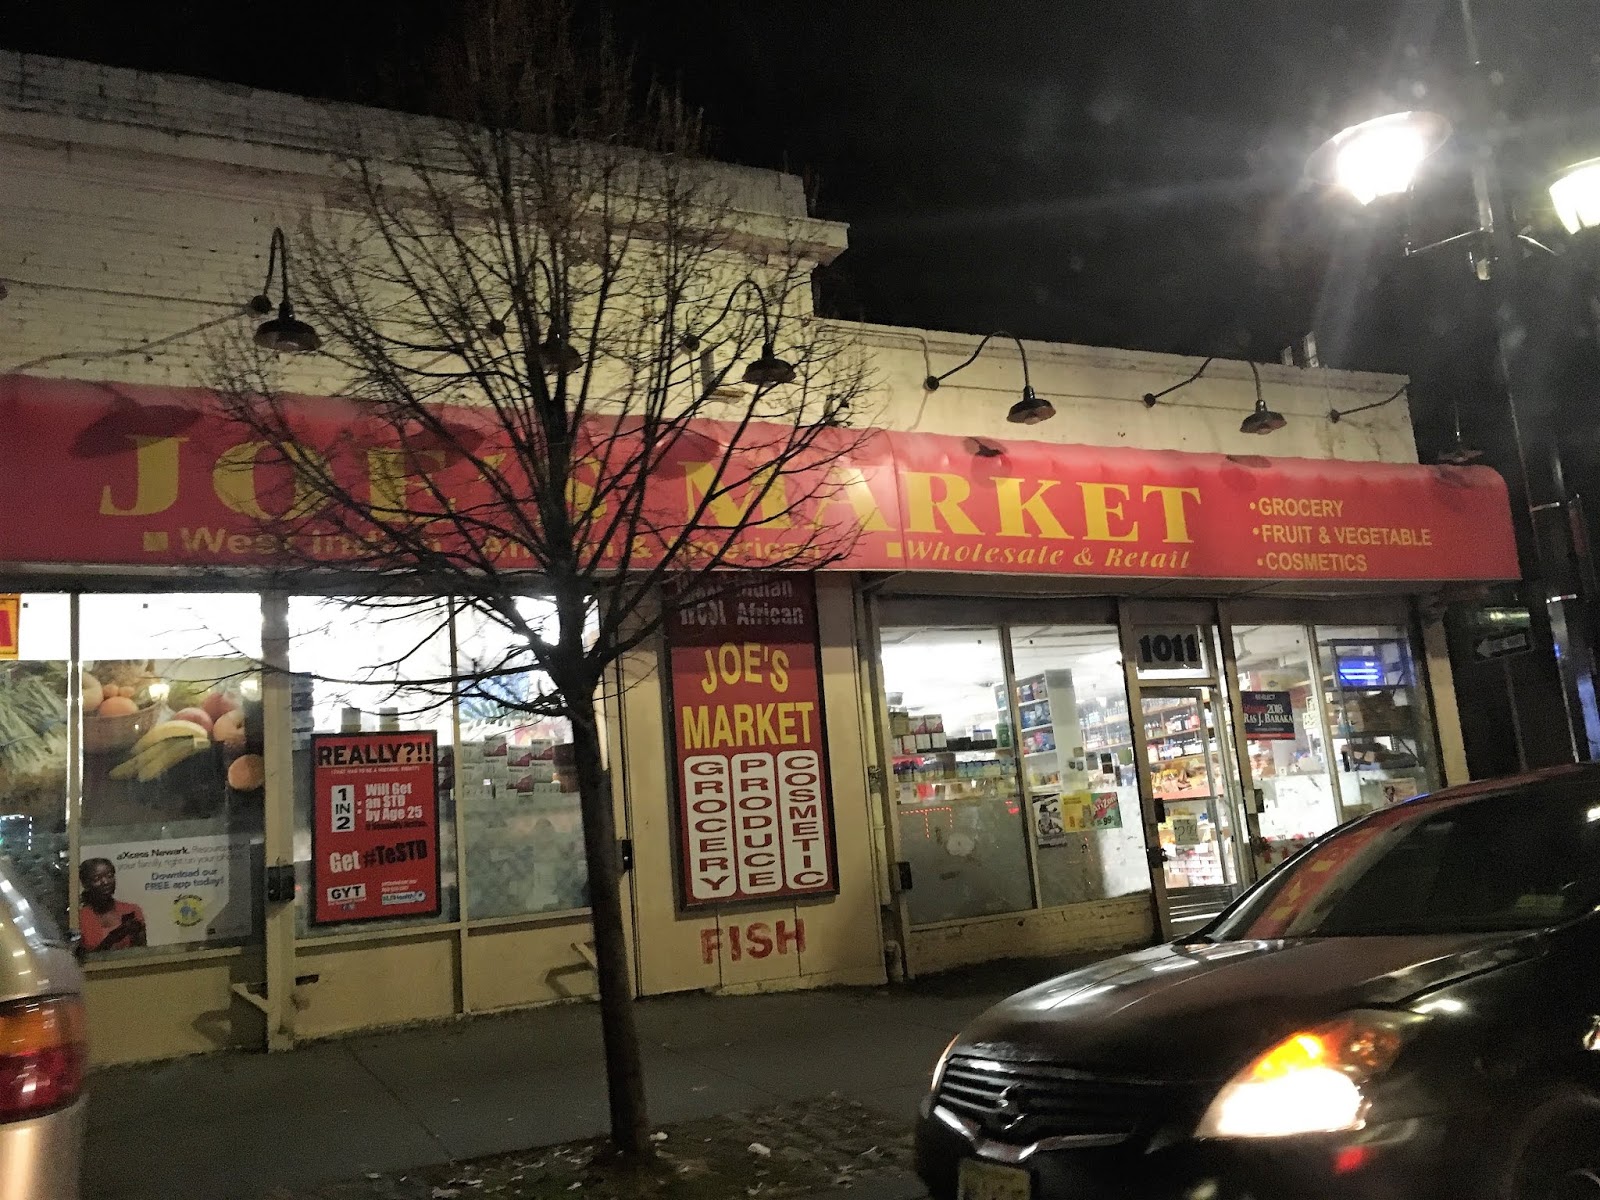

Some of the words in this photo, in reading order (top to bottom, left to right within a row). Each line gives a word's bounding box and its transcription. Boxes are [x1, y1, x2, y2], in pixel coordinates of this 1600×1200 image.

[676, 459, 1202, 543] MARKET
[1258, 497, 1344, 517] GROCERY
[1262, 524, 1312, 544] FRUIT
[1318, 526, 1331, 544] &
[1334, 527, 1433, 546] VEGETABLE
[907, 539, 1064, 567] Wholesale
[1073, 545, 1094, 567] &
[1105, 547, 1191, 570] Retail
[1266, 551, 1368, 572] COSMETICS
[736, 601, 805, 626] African
[1139, 633, 1198, 662] 1011
[701, 641, 790, 694] JOE'S
[682, 702, 815, 750] MARKET
[317, 742, 431, 766] REALLY?!!
[337, 787, 347, 802] 1
[365, 783, 390, 797] Will
[392, 782, 412, 795] Get
[335, 803, 350, 815] IN
[365, 797, 381, 809] an
[383, 794, 406, 808] STD
[336, 817, 350, 830] 2
[365, 809, 381, 822] by
[382, 808, 406, 822] Age
[407, 805, 423, 819] 25
[738, 758, 776, 887] PRODUCE
[784, 755, 825, 886] COSMETIC
[690, 761, 731, 891] GROCERY
[329, 850, 362, 873] Get
[363, 839, 428, 868] #TeSTD
[145, 881, 170, 891] FREE
[173, 881, 191, 890] app
[151, 868, 200, 881] Download
[331, 885, 361, 900] GYT
[700, 917, 807, 965] FISH
